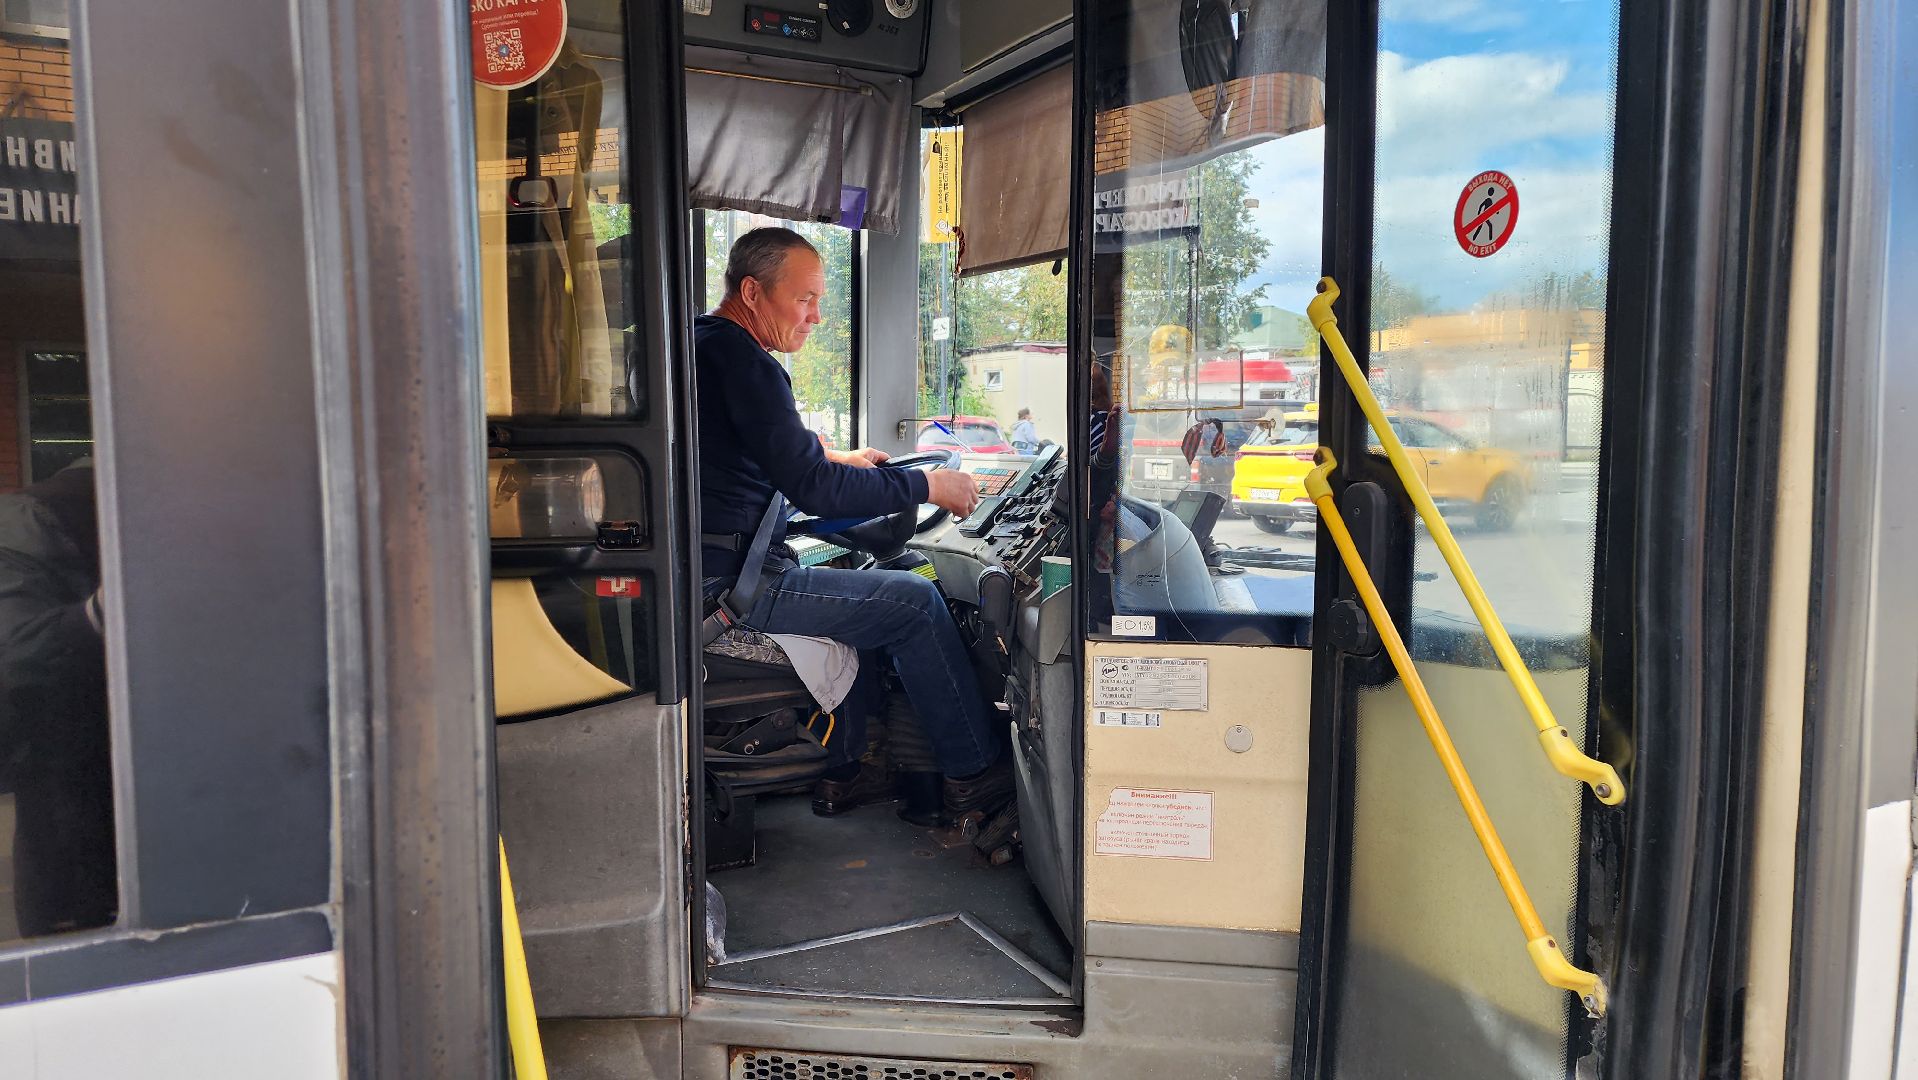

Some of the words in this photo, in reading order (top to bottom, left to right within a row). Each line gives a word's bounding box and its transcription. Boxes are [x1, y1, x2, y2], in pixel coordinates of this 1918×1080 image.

[1468, 173, 1498, 192] ВЫХОДА
[1498, 175, 1514, 190] НЕТ
[1467, 244, 1479, 255] NO
[1480, 242, 1498, 256] EXIT
[1131, 791, 1177, 800] Внимание!!!
